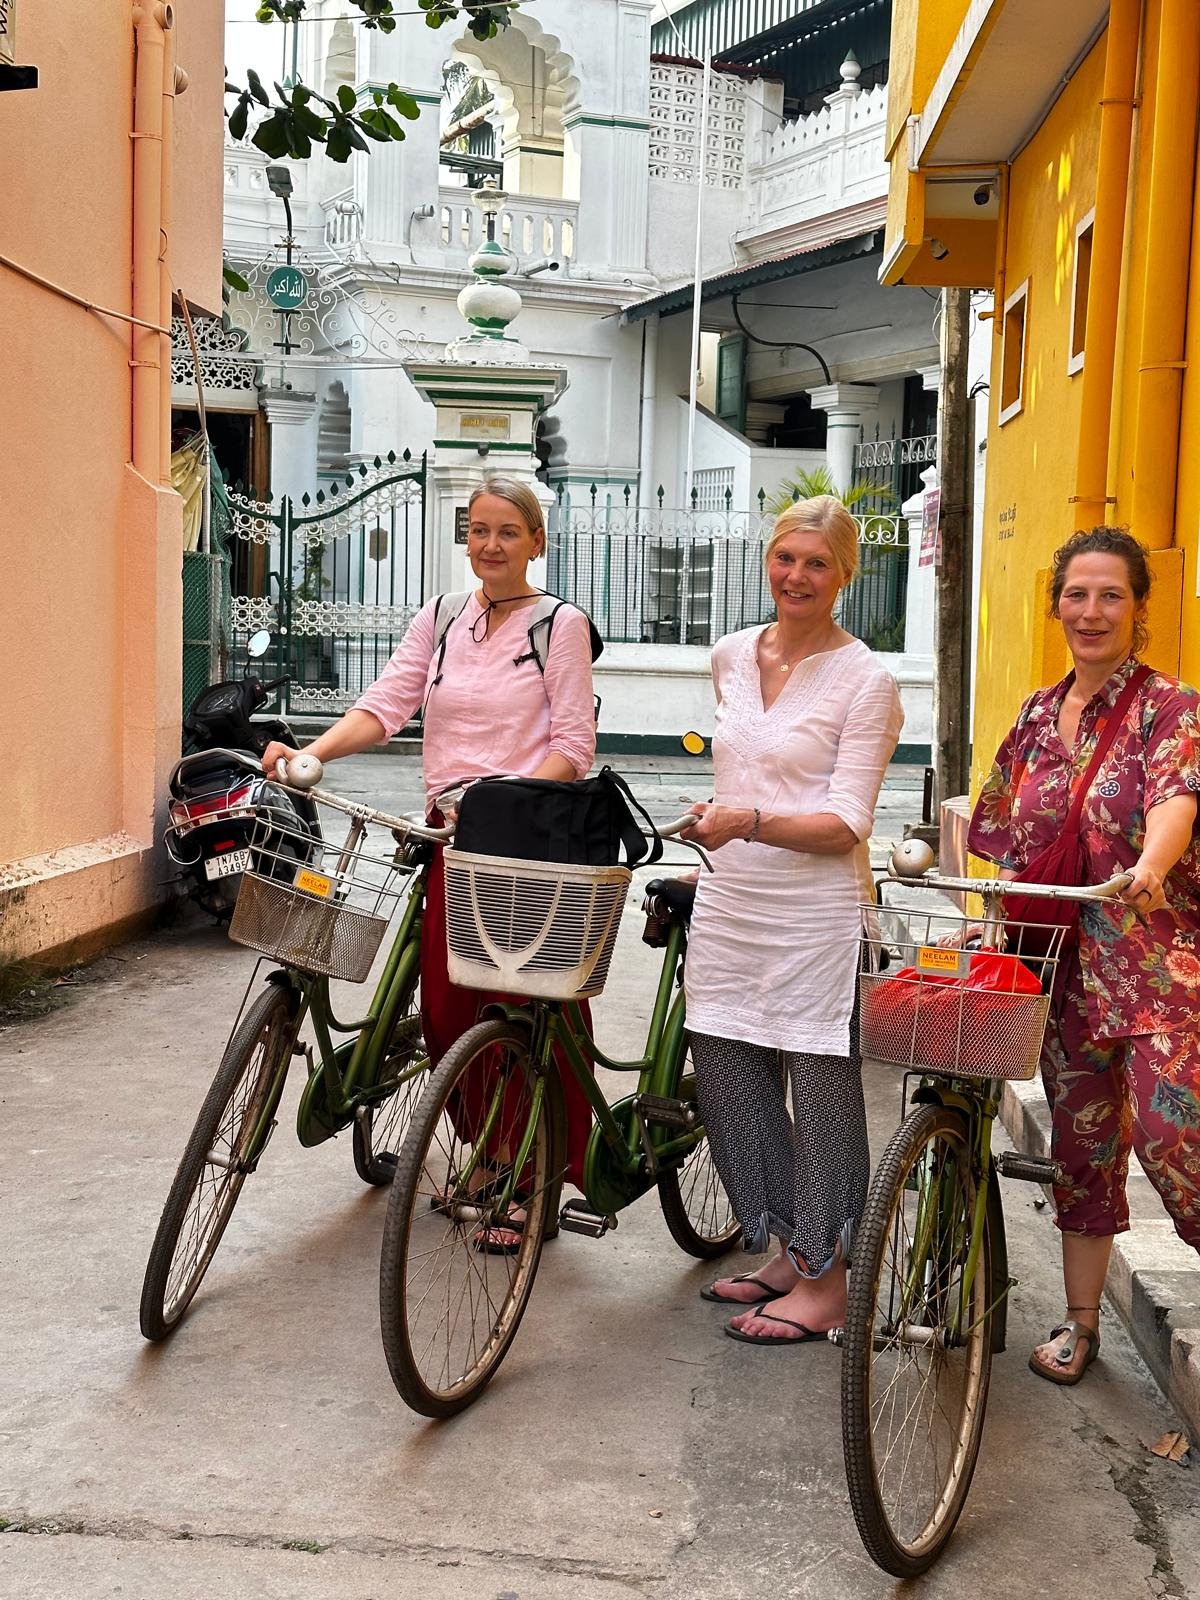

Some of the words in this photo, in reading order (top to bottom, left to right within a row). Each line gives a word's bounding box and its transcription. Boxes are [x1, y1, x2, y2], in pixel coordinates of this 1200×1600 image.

[289, 276, 304, 298] الله
[216, 851, 245, 866] TN76B
[922, 952, 956, 962] NEELAM
